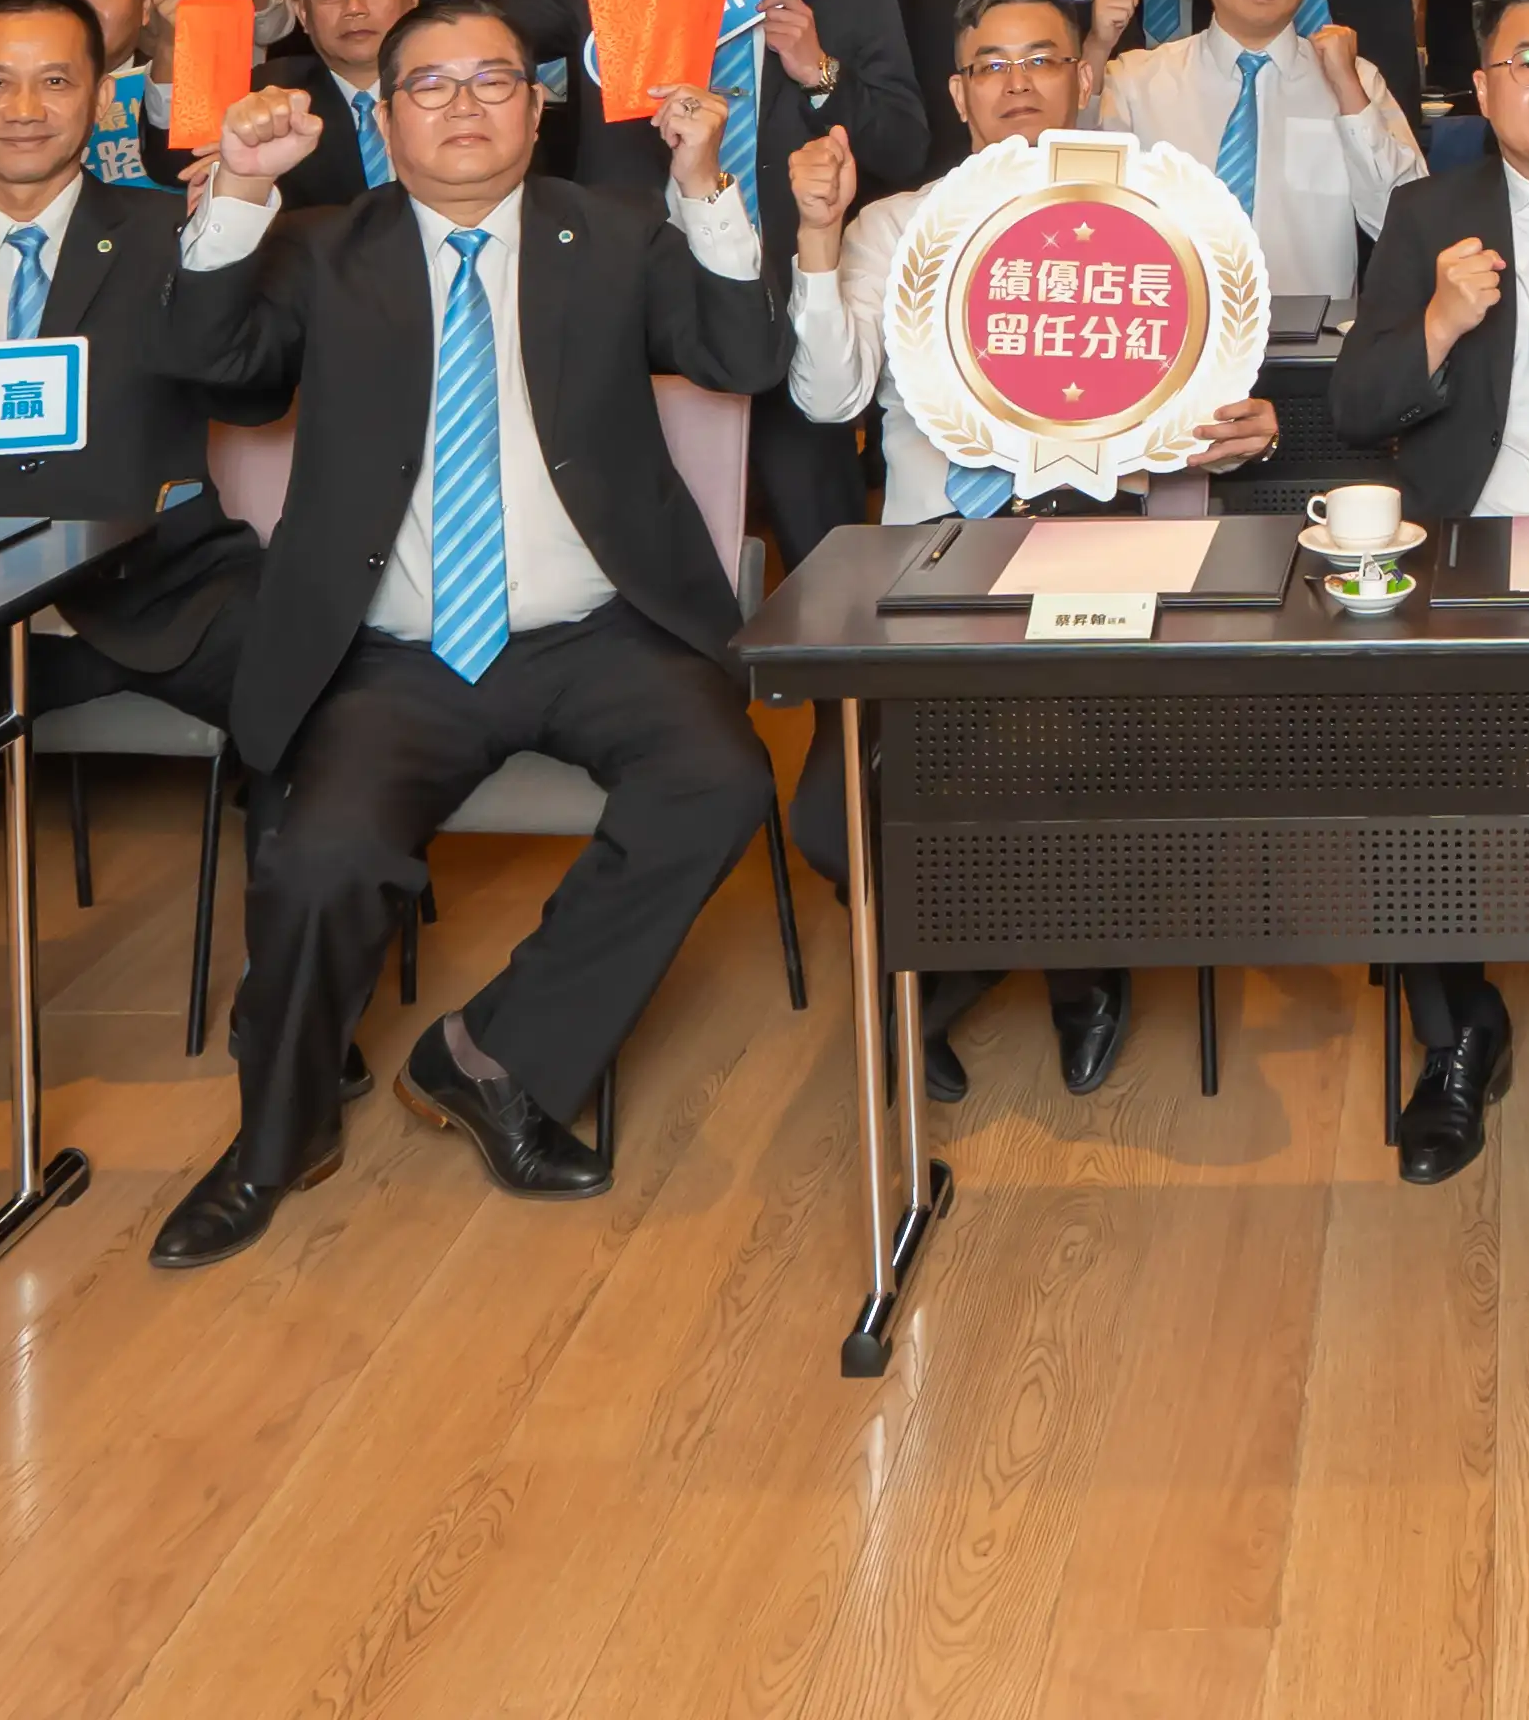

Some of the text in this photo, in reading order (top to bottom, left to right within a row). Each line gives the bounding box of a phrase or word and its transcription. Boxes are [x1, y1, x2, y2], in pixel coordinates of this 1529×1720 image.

[990, 258, 1172, 309] 績優店長
[986, 313, 1169, 363] 留任分紅
